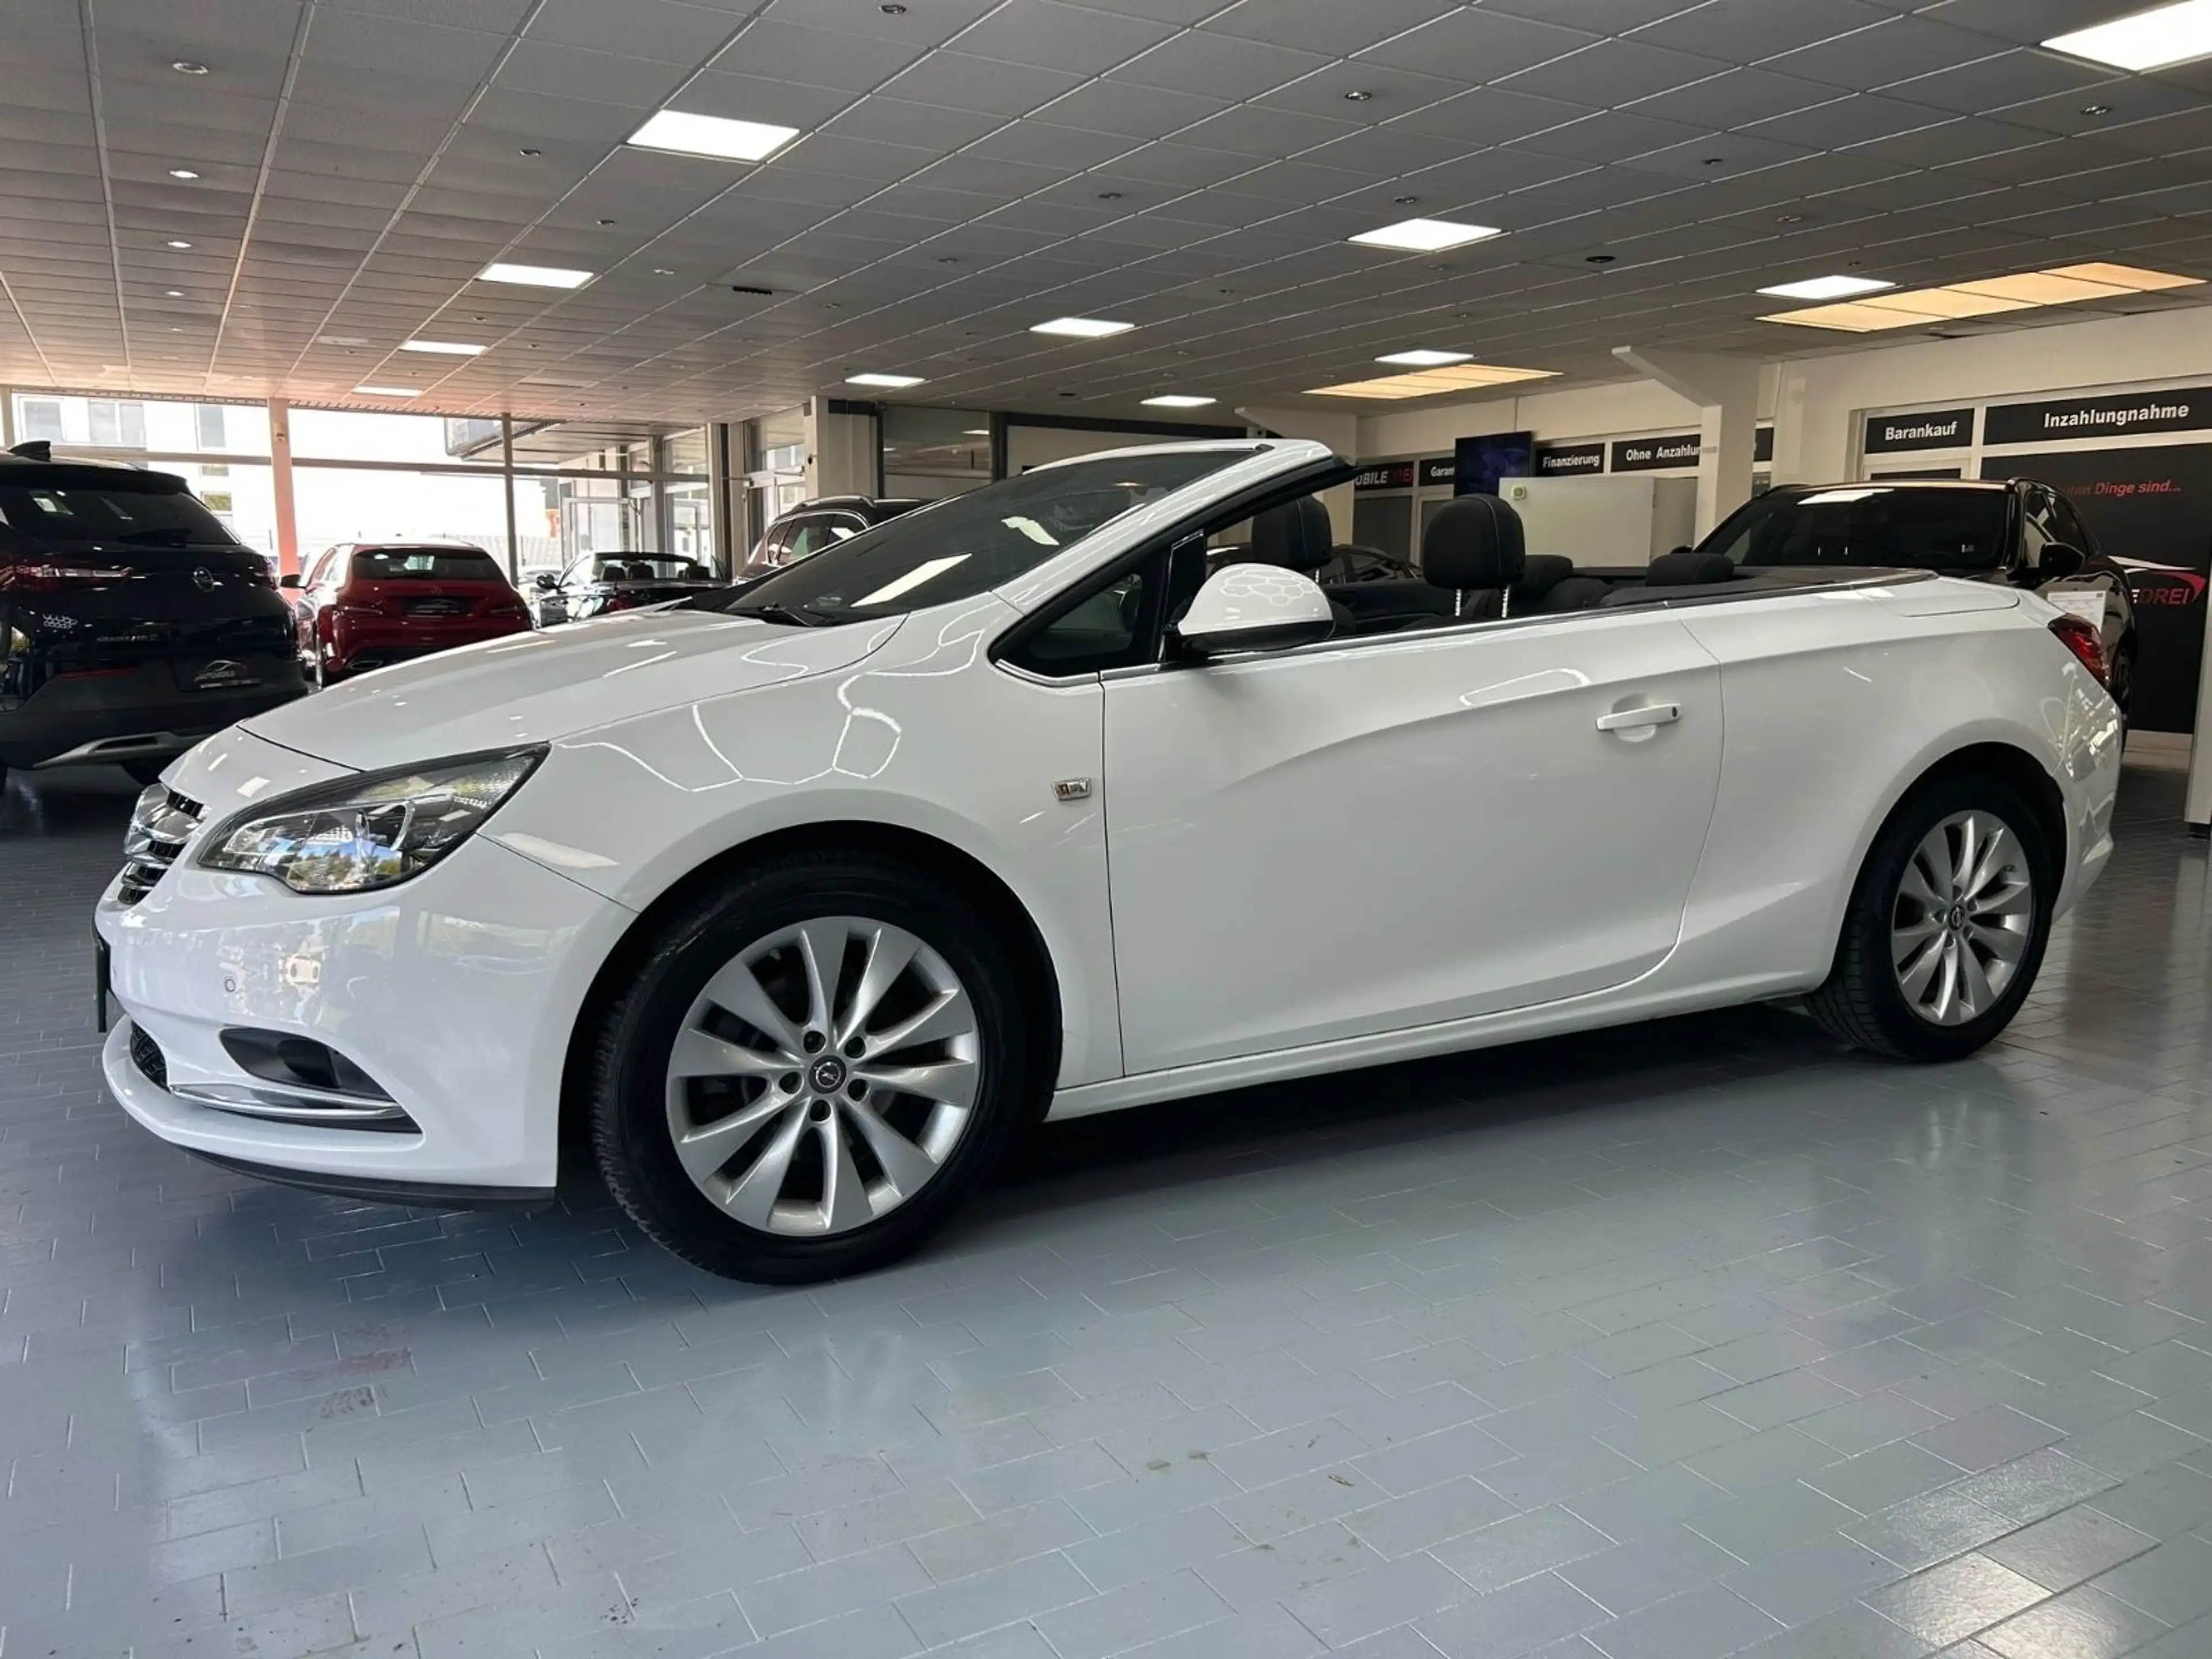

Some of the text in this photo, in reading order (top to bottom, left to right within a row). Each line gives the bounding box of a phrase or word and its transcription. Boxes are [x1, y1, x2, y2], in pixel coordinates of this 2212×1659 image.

[2044, 404, 2190, 427] Inzahlungnahme
[1885, 421, 1957, 441] Barankauf
[1543, 454, 1600, 468] Finanzierung
[1626, 449, 1652, 461] Ohne
[2094, 481, 2134, 497] Dinge
